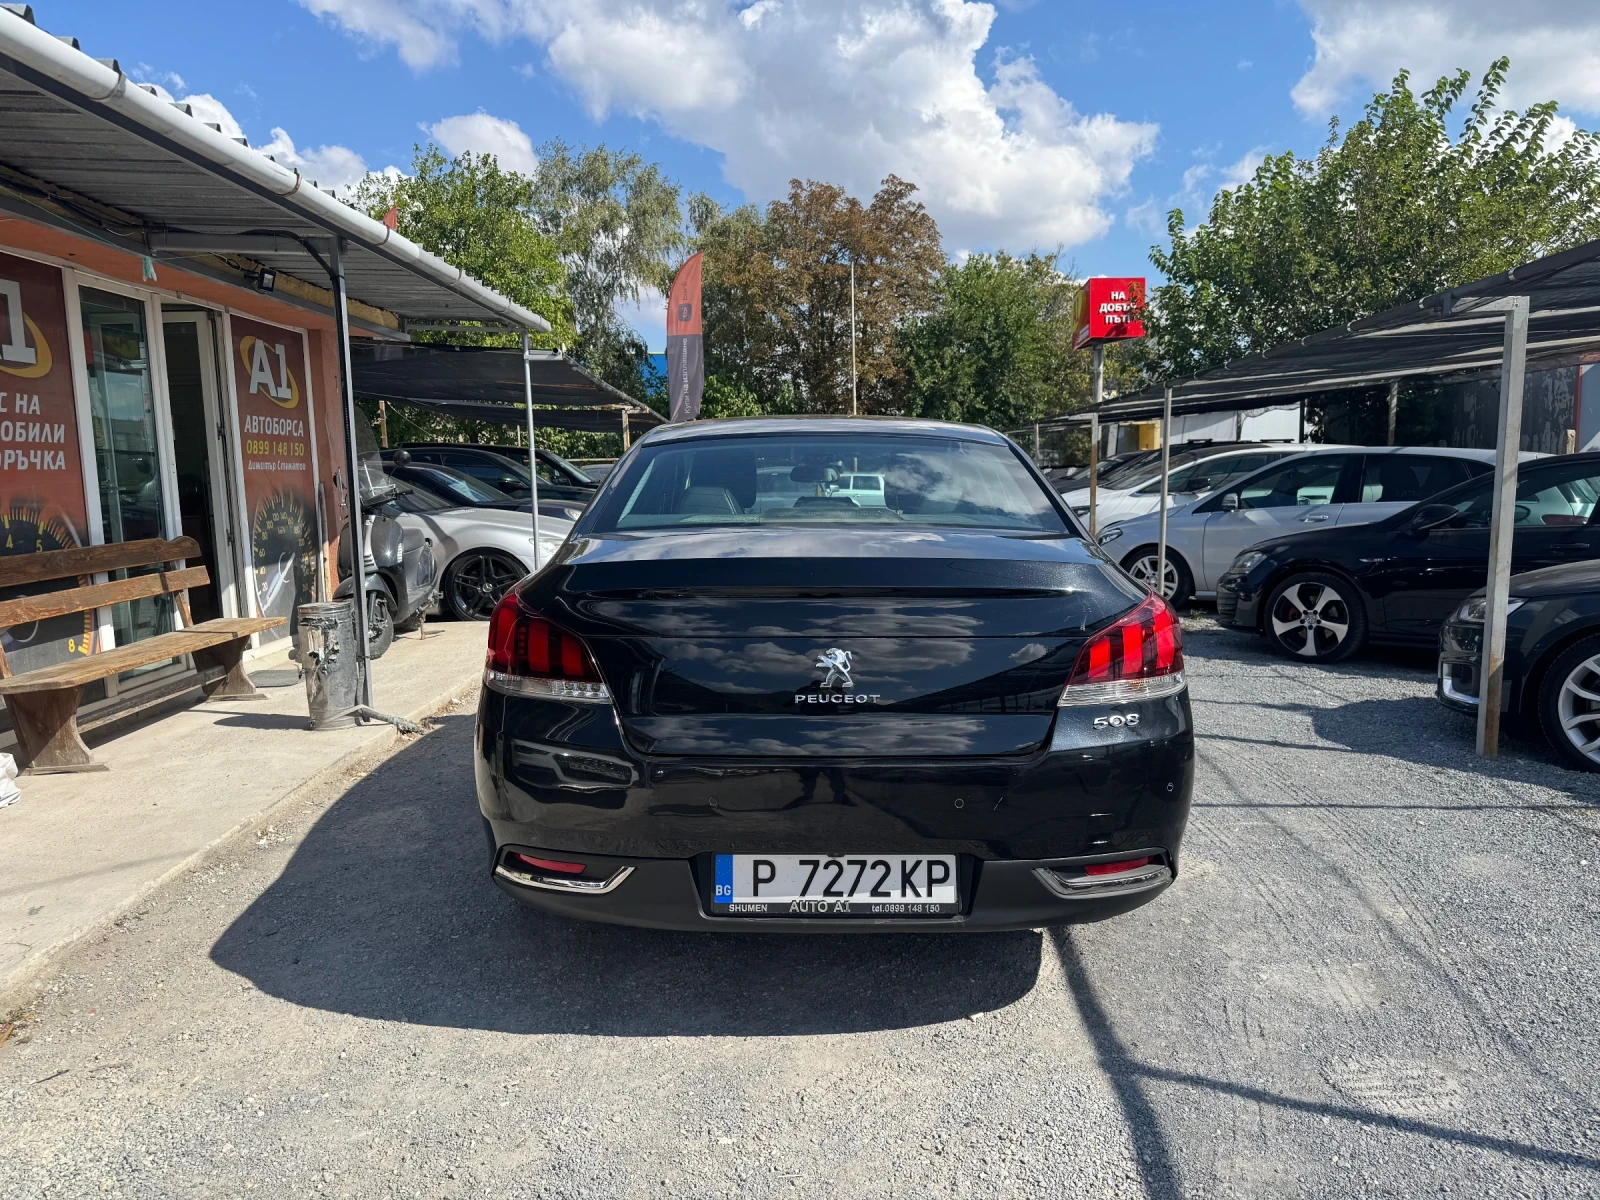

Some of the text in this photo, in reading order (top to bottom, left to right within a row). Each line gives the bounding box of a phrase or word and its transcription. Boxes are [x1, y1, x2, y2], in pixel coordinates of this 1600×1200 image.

[1111, 291, 1126, 300] НА
[0, 279, 37, 364] 1
[683, 384, 689, 394] на
[15, 393, 41, 415] НА
[244, 415, 304, 437] АВТОБОРСА
[246, 440, 305, 456] 0899 148 150
[0, 450, 66, 471] РЪЧКА
[6, 534, 13, 548] 4
[36, 540, 43, 553] 5
[259, 548, 266, 558] 60
[262, 582, 268, 592] 20
[68, 638, 75, 653] 8
[794, 694, 880, 704] PEUGEOT
[1093, 713, 1139, 730] 508
[752, 859, 776, 897] P
[715, 885, 732, 896] BG
[728, 900, 940, 913] SHUMEN AUTO A1 tel.0899 148 150
